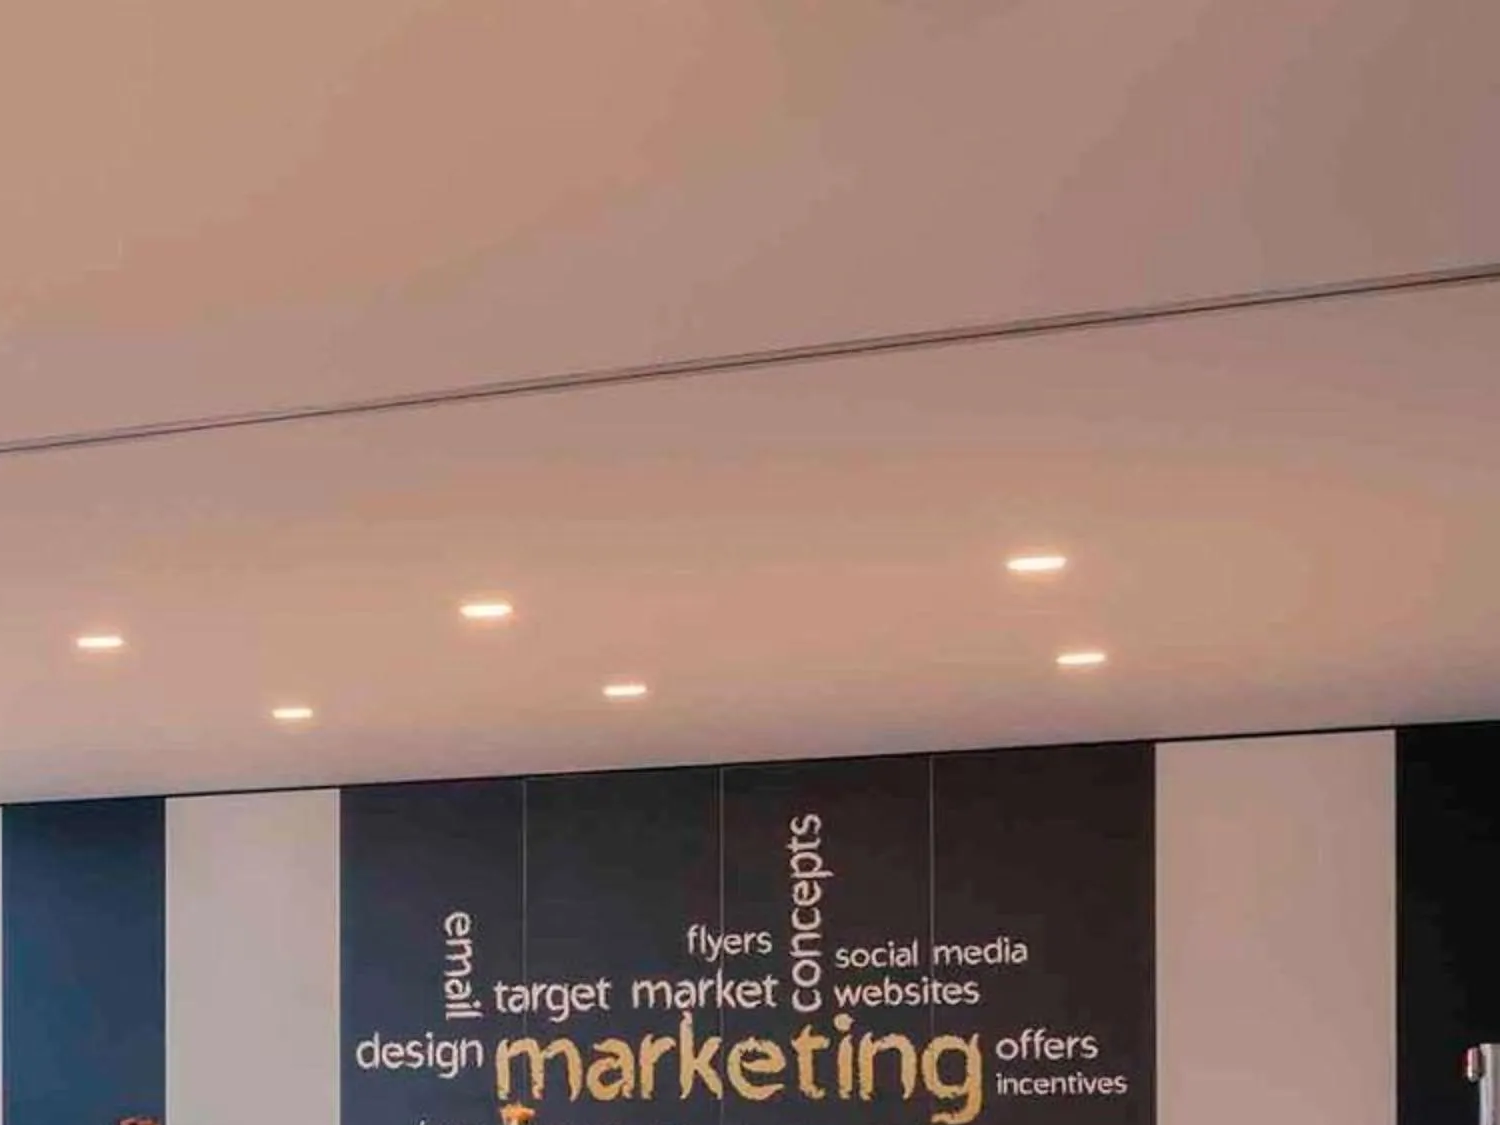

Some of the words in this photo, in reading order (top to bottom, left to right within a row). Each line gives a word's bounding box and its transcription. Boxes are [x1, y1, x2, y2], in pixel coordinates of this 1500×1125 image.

[788, 813, 834, 1013] concepts
[687, 924, 773, 962] flyers
[835, 938, 919, 968] social
[932, 937, 1029, 966] media
[444, 911, 484, 1020] email
[492, 977, 612, 1022] target
[631, 968, 779, 1009] market
[833, 976, 981, 1007] websites
[356, 1031, 484, 1079] design
[995, 1028, 1100, 1061] offers
[495, 1010, 983, 1125] marketing
[996, 1071, 1128, 1096] incentives
